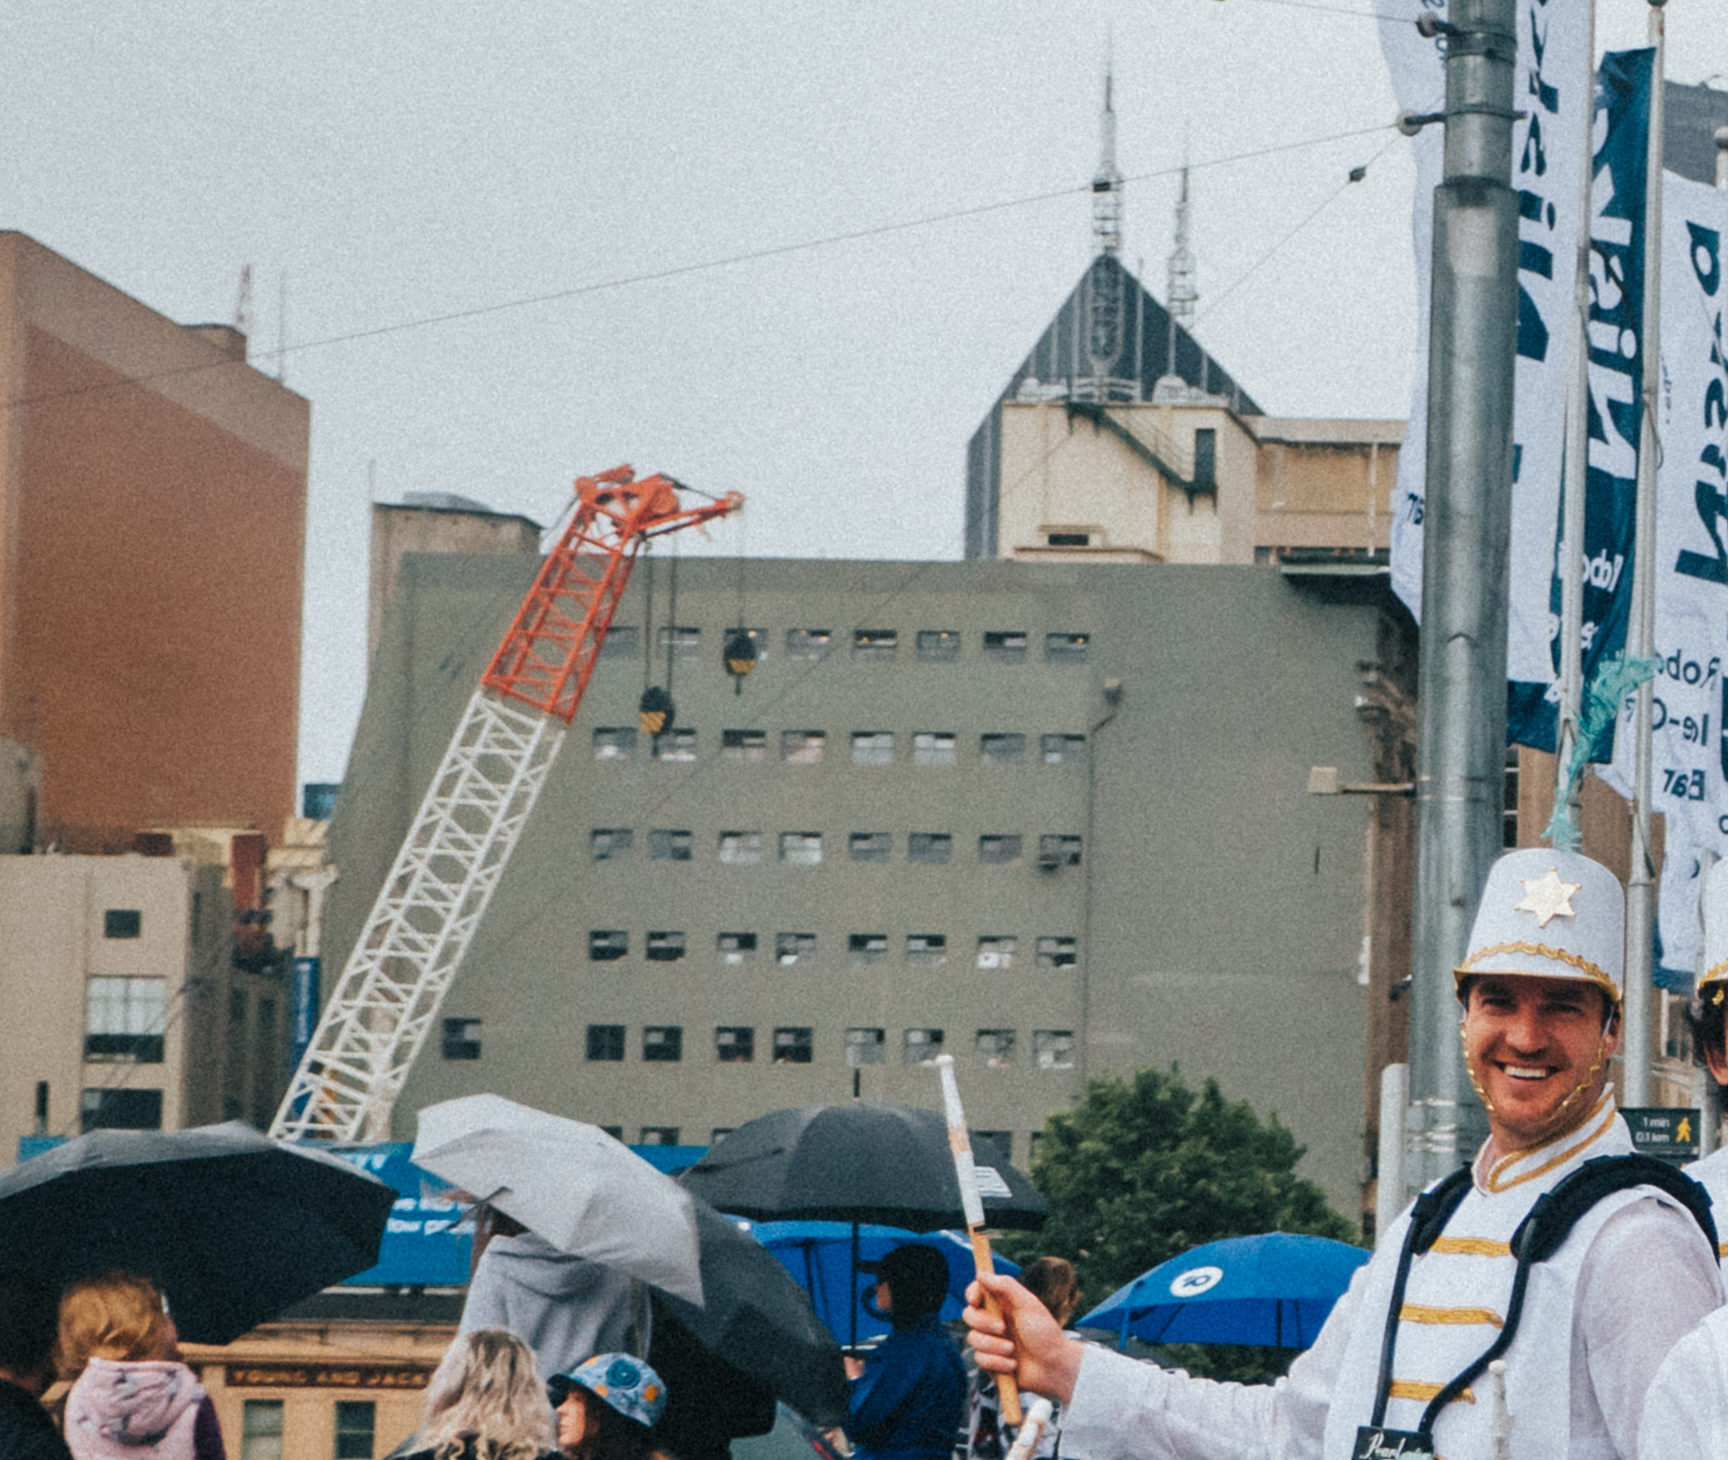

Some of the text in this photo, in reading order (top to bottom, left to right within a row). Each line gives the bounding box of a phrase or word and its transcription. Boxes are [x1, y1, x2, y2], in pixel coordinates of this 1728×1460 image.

[1650, 1116, 1670, 1128] min
[1651, 1131, 1670, 1143] km
[367, 1372, 433, 1386] JACK
[1358, 1431, 1407, 1460] Pearl
